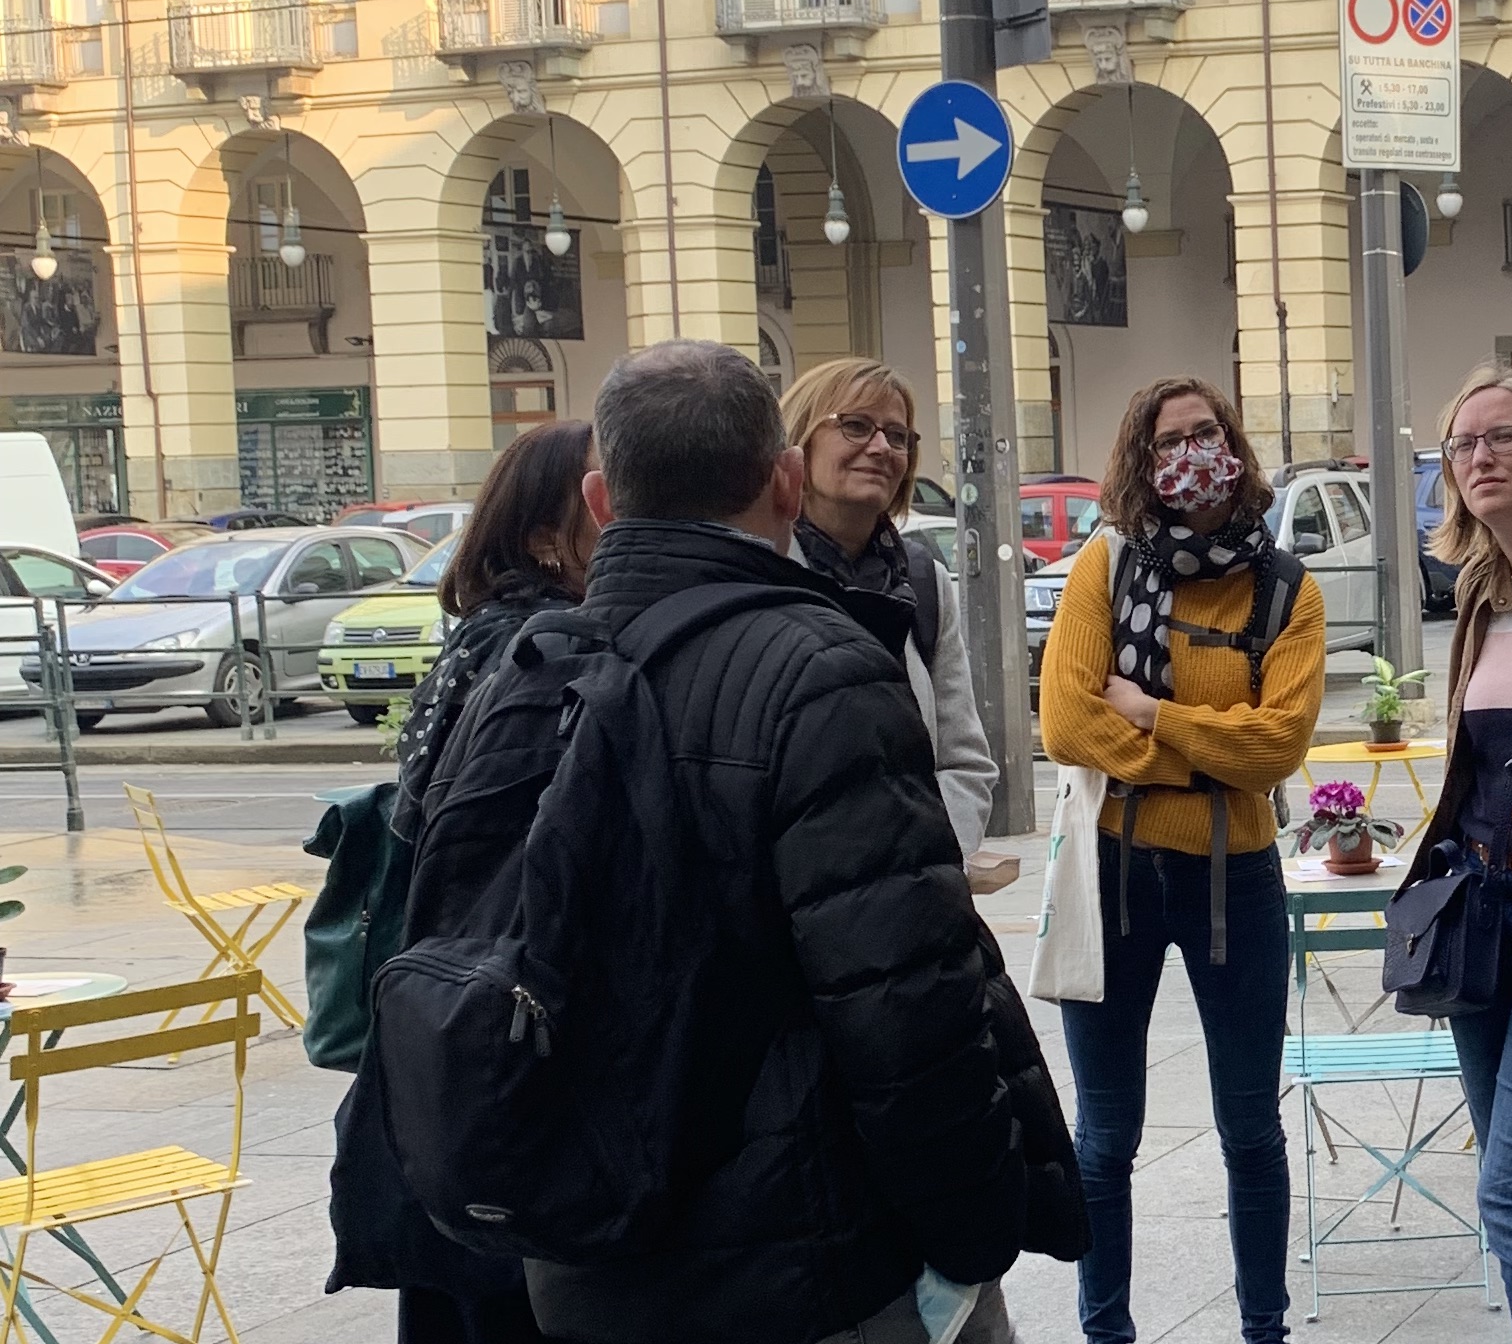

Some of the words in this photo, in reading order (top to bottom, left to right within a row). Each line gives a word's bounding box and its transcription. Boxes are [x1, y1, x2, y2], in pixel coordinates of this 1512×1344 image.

[1348, 55, 1360, 65] SU
[1363, 56, 1391, 66] TUTTA
[1394, 58, 1405, 67] LA
[1407, 59, 1452, 70] BANCHINA
[1408, 84, 1428, 96] 17,00
[1357, 98, 1396, 110] Prefestivi
[1402, 101, 1419, 112] 5,30
[1425, 102, 1445, 113] 23,00
